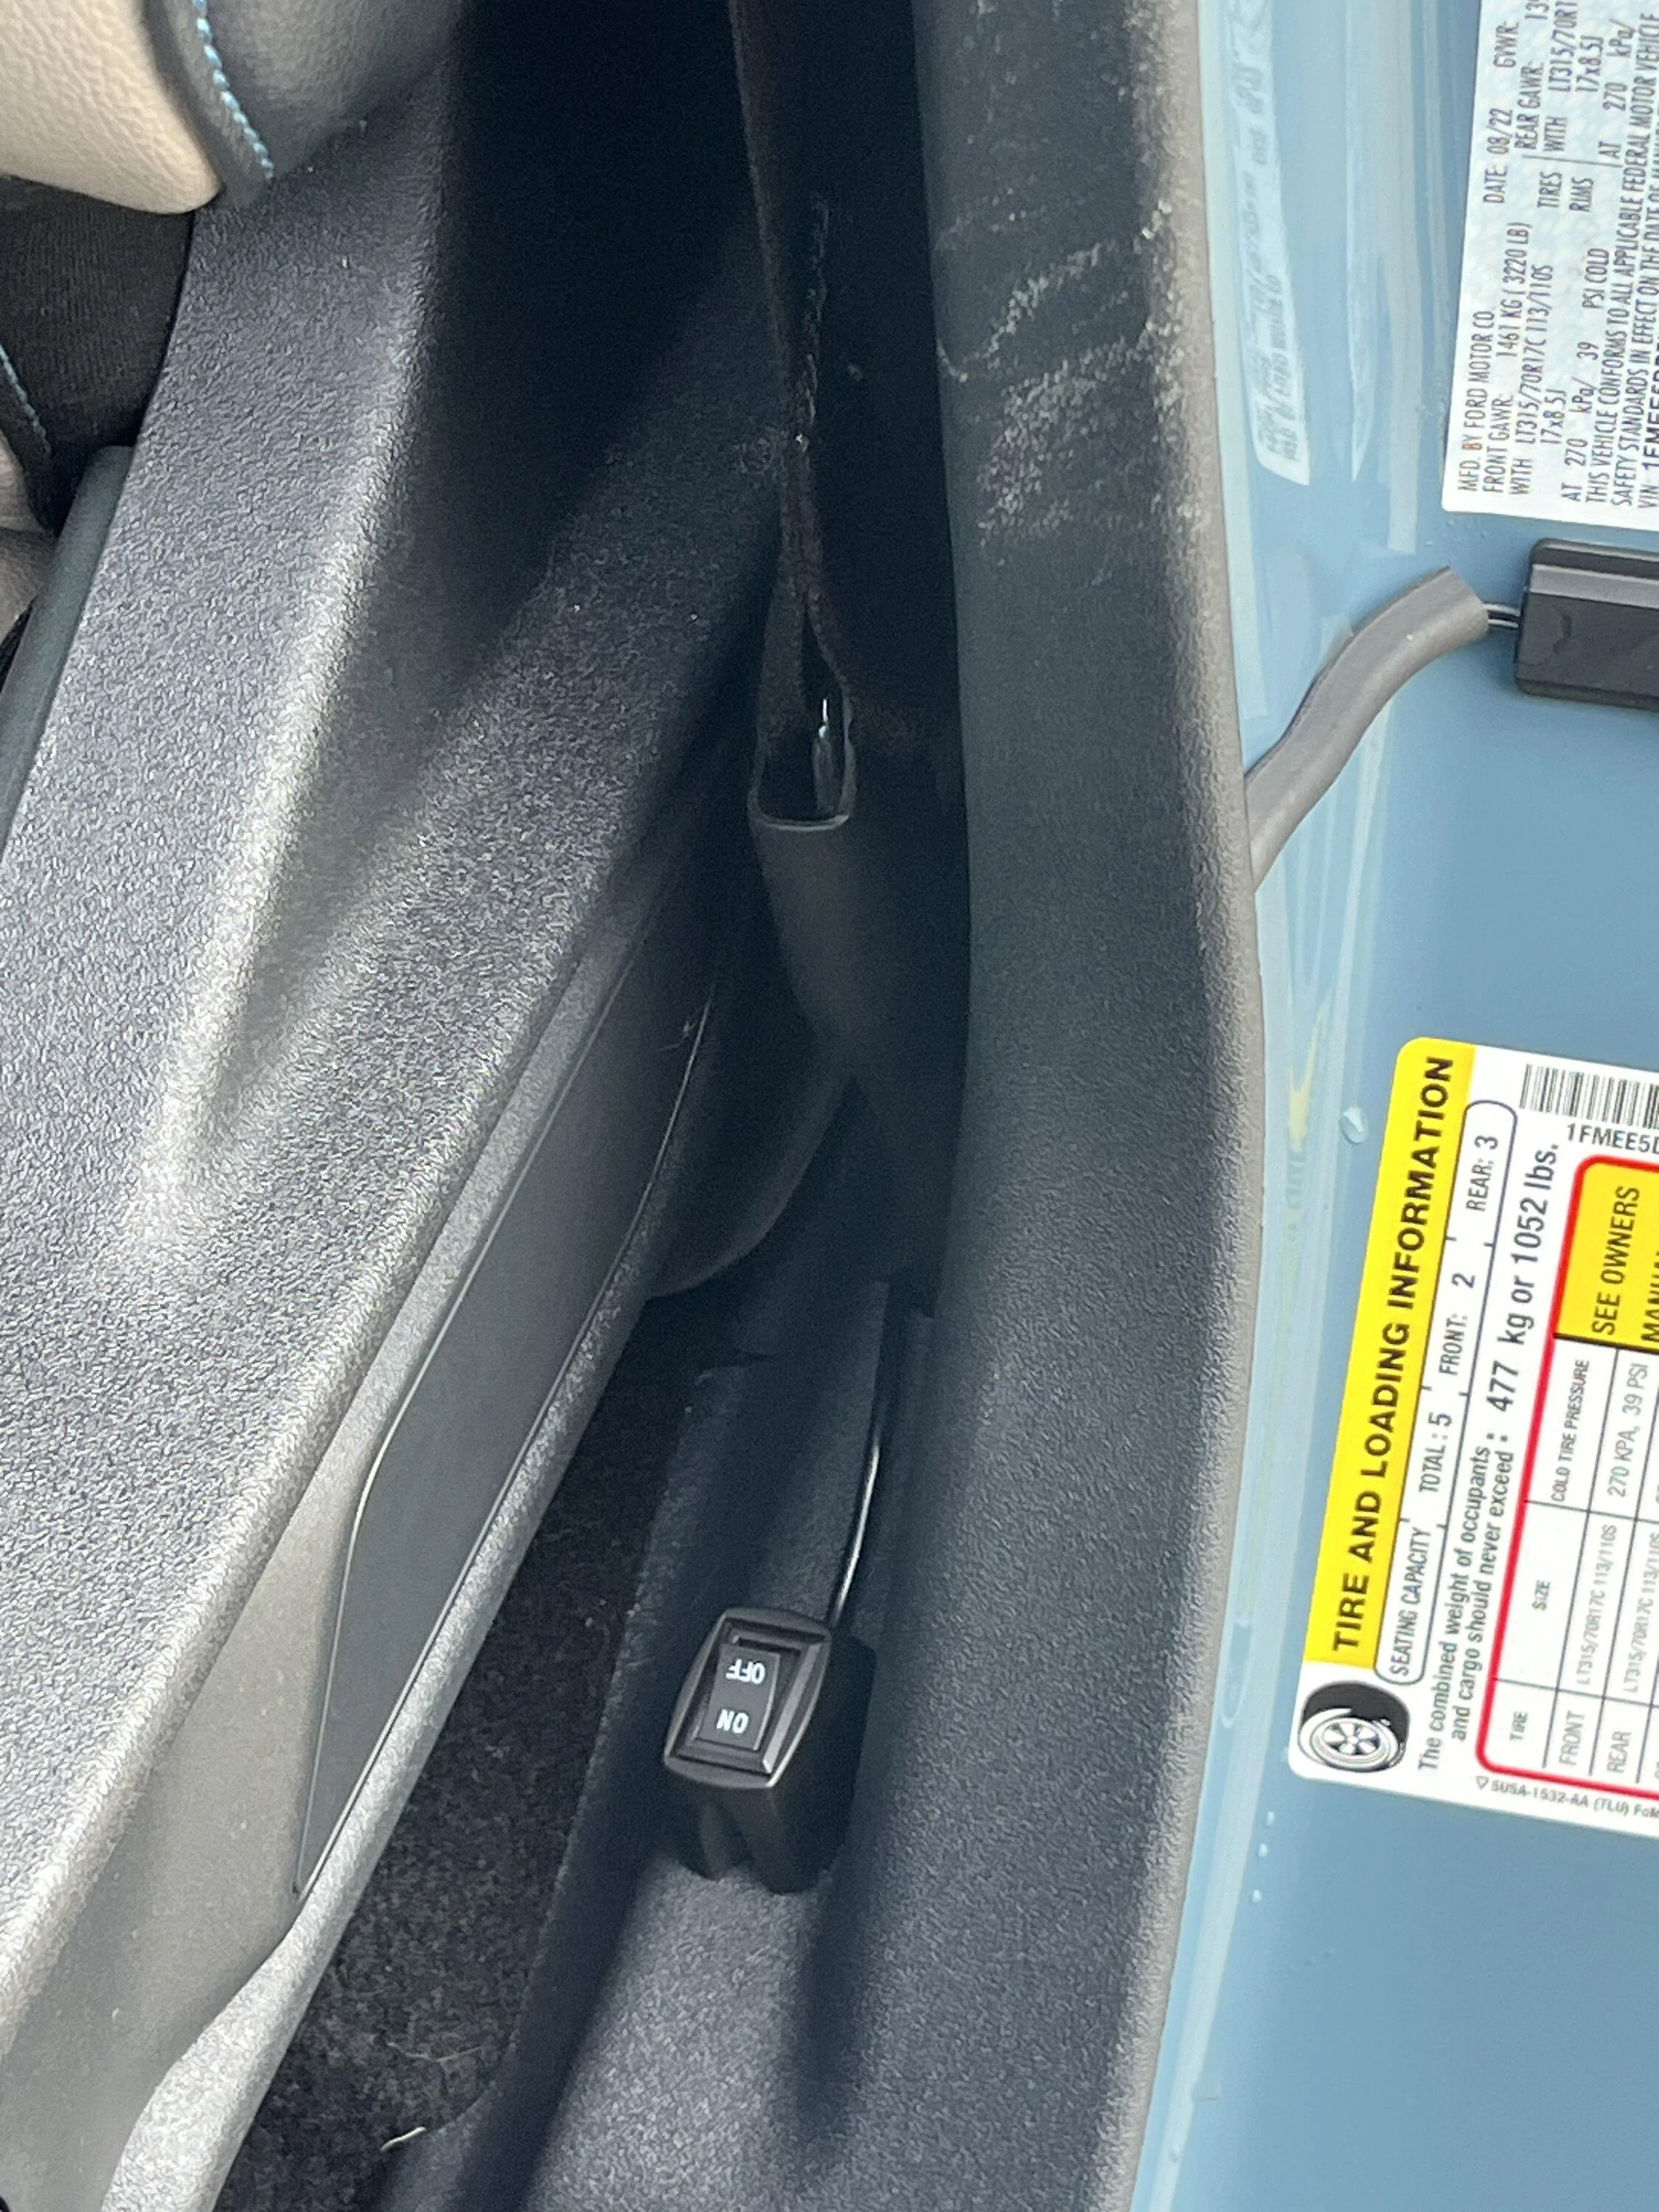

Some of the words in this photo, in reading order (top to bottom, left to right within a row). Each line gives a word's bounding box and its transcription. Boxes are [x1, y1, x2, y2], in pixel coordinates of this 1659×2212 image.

[1602, 82, 1628, 111] 270
[1628, 76, 1657, 129] MOTOR
[1486, 108, 1512, 155] 08/22
[1513, 114, 1540, 149] REAR
[1542, 116, 1568, 152] WITH
[1597, 141, 1621, 159] AT
[1621, 133, 1651, 192] FEDERAL
[1568, 177, 1594, 213] RIMS
[1613, 195, 1644, 277] APPLICABLE
[1584, 248, 1610, 284] COLD
[1499, 299, 1523, 319] KG
[1582, 288, 1605, 310] PSI
[1610, 282, 1633, 305] ALL
[1509, 457, 1533, 495] WITH
[1537, 171, 1562, 209] TIRES
[1607, 307, 1630, 325] TO
[1631, 299, 1658, 344] EFFECT
[1467, 333, 1493, 383] MOTOR
[1495, 324, 1520, 358] 1461
[1576, 341, 1599, 361] 39
[1628, 349, 1652, 364] IN
[1597, 330, 1627, 405] CONFORMS
[1463, 388, 1488, 429] FORD
[1618, 368, 1649, 451] STANDARDS
[1461, 434, 1483, 451] BY
[1564, 438, 1588, 467] 270
[1590, 410, 1618, 467] VEHICLE
[1482, 446, 1509, 493] FRONT
[1585, 472, 1610, 503] THIS
[1610, 454, 1638, 507] SAFETY
[1560, 482, 1583, 502] AT
[1475, 1135, 1498, 1150] 3
[1386, 1056, 1454, 1310] INFORMATION
[1465, 1158, 1494, 1211] REAR:
[1523, 1144, 1558, 1191] lbs.
[1510, 1197, 1548, 1264] 1052
[1600, 1186, 1640, 1285] OWNERS
[1451, 1273, 1475, 1288] 2
[1511, 1276, 1534, 1304] or
[1498, 1313, 1534, 1345] kg
[1591, 1292, 1621, 1335] SEE
[1438, 1313, 1467, 1376] FRONT:
[1486, 1360, 1519, 1412] 477
[1563, 1360, 1589, 1430] PRESSURE
[1627, 1363, 1648, 1389] PSI
[1360, 1323, 1410, 1478] LOADING
[1427, 1412, 1452, 1427] 5
[1621, 1394, 1644, 1416] 39
[1557, 1433, 1576, 1461] TIRE
[1460, 1446, 1490, 1543] occupants
[1489, 1450, 1514, 1517] exceed
[1551, 1467, 1571, 1502] COLD
[1607, 1466, 1630, 1498] 270
[1348, 1491, 1381, 1562] AND
[1400, 1527, 1431, 1604] CAPACITY
[1453, 1548, 1473, 1567] of
[1478, 1523, 1502, 1575] never
[1332, 1572, 1369, 1651] TIRE
[1444, 1573, 1470, 1635] weight
[1464, 1580, 1492, 1643] should
[1531, 1579, 1551, 1611] SIZE
[1389, 1611, 1419, 1676] SEATING
[726, 1658, 765, 1684] OFF
[1429, 1641, 1457, 1732] combined
[1458, 1648, 1483, 1700] cargo
[717, 1709, 749, 1733] ON
[1451, 1705, 1470, 1741] and
[1509, 1711, 1528, 1741] TIRE
[1558, 1710, 1585, 1765] FRONT
[1417, 1737, 1442, 1770] The
[1606, 1731, 1632, 1773] REAR
